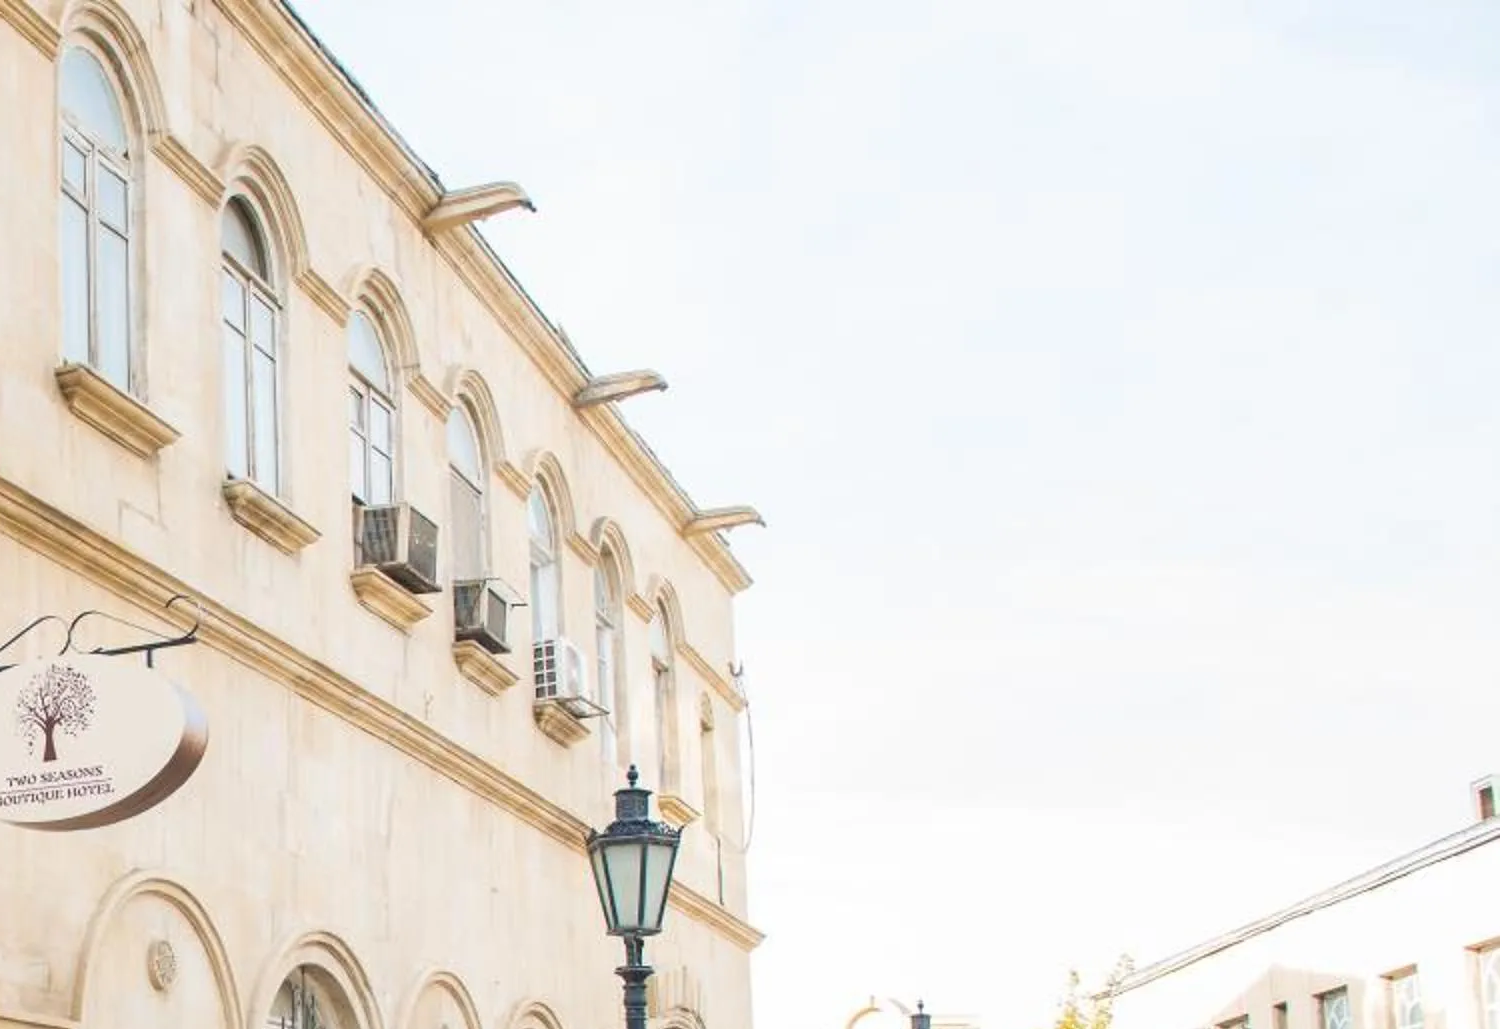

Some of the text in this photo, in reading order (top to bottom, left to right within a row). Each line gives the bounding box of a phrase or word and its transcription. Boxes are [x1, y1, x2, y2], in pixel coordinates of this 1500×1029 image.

[6, 766, 104, 788] TWO SEASONS
[67, 783, 115, 798] HOTEL
